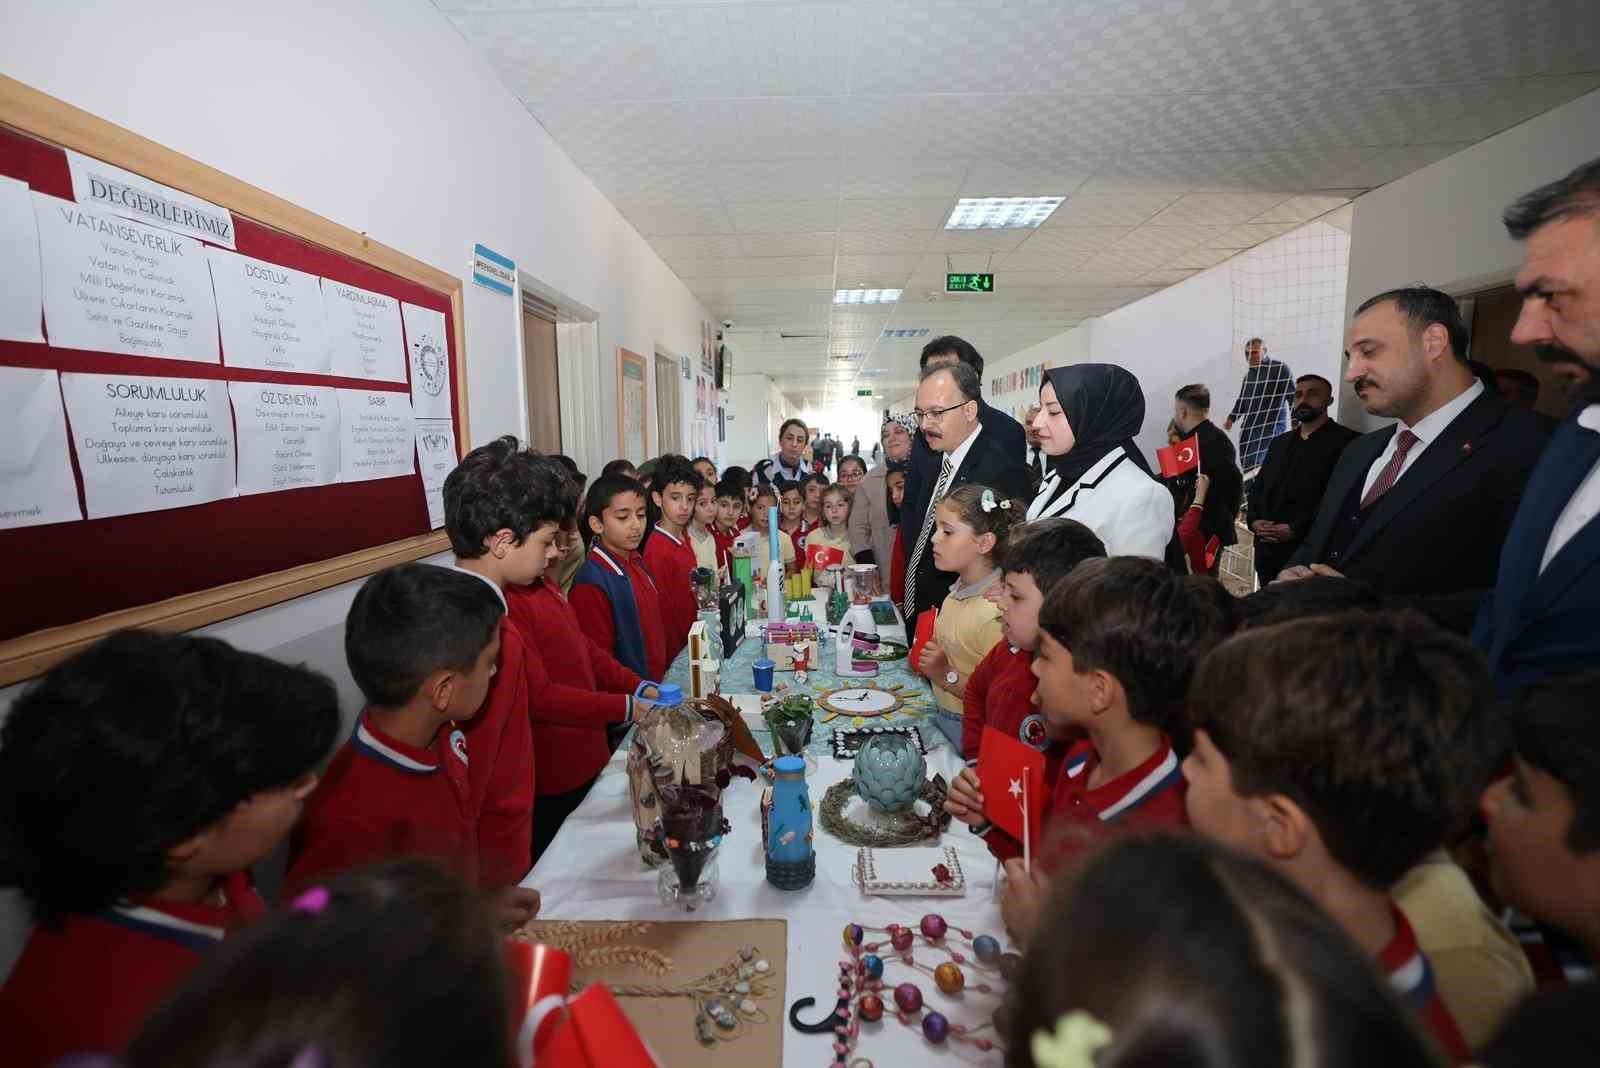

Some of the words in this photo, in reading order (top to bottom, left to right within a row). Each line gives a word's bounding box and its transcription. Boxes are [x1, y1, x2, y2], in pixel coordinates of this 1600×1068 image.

[89, 178, 231, 240] DEĞERLERİMİZ
[60, 206, 184, 256] VATANSEVERLİK
[245, 263, 290, 285] DOSTLUK
[106, 382, 208, 402] SORUMLULUK
[84, 438, 127, 452] Doğaya
